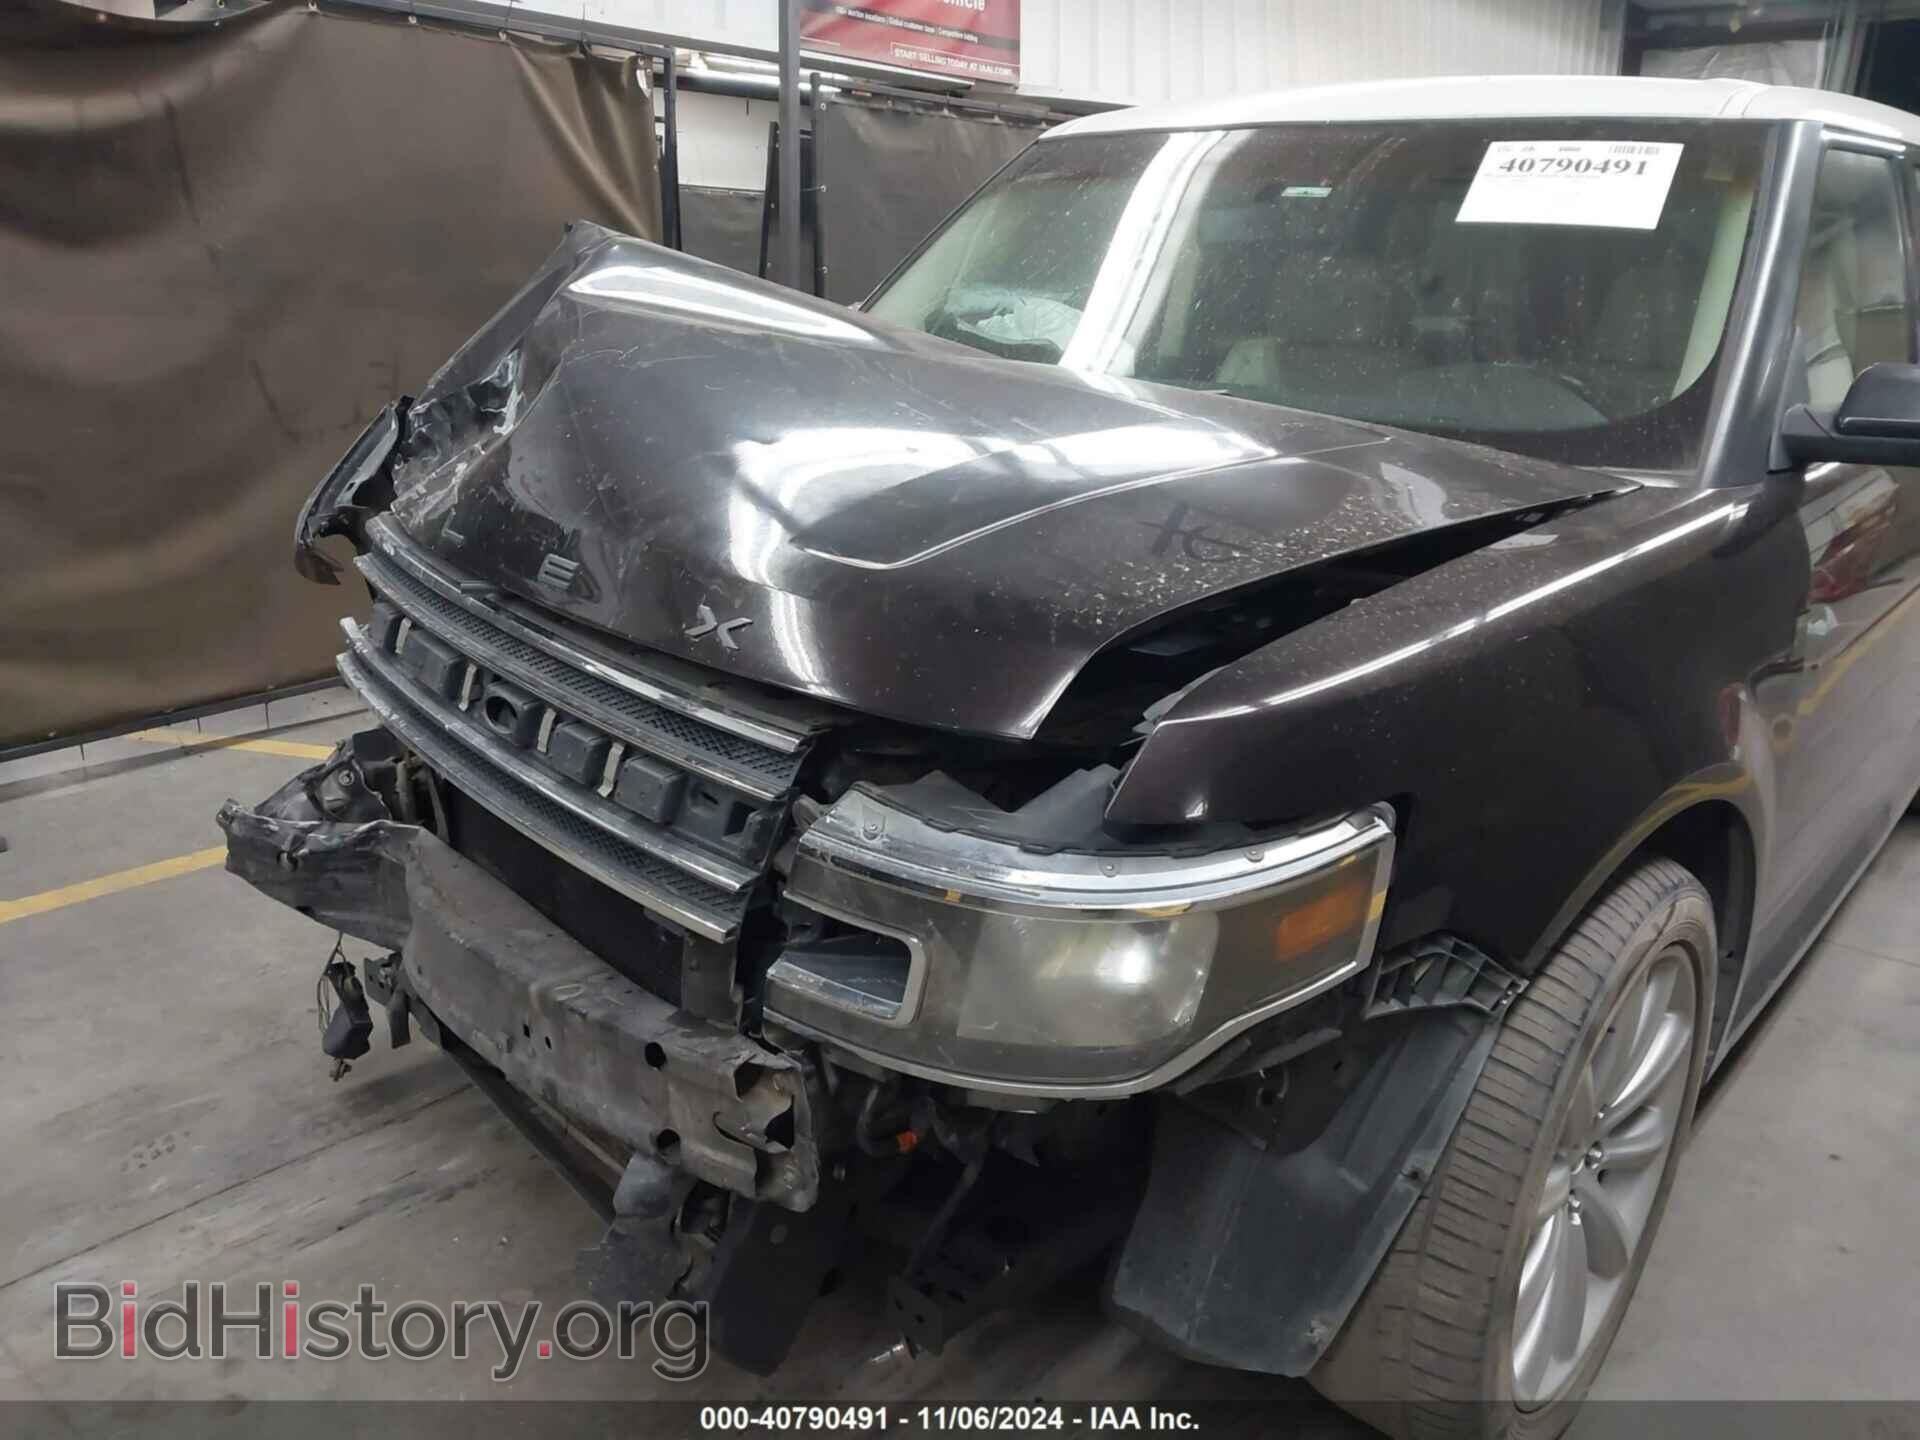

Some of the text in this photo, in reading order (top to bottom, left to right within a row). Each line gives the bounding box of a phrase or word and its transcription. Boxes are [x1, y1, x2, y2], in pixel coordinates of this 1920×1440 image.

[895, 48, 916, 59] START
[919, 52, 946, 65] SELLING
[1499, 157, 1648, 176] 40790491
